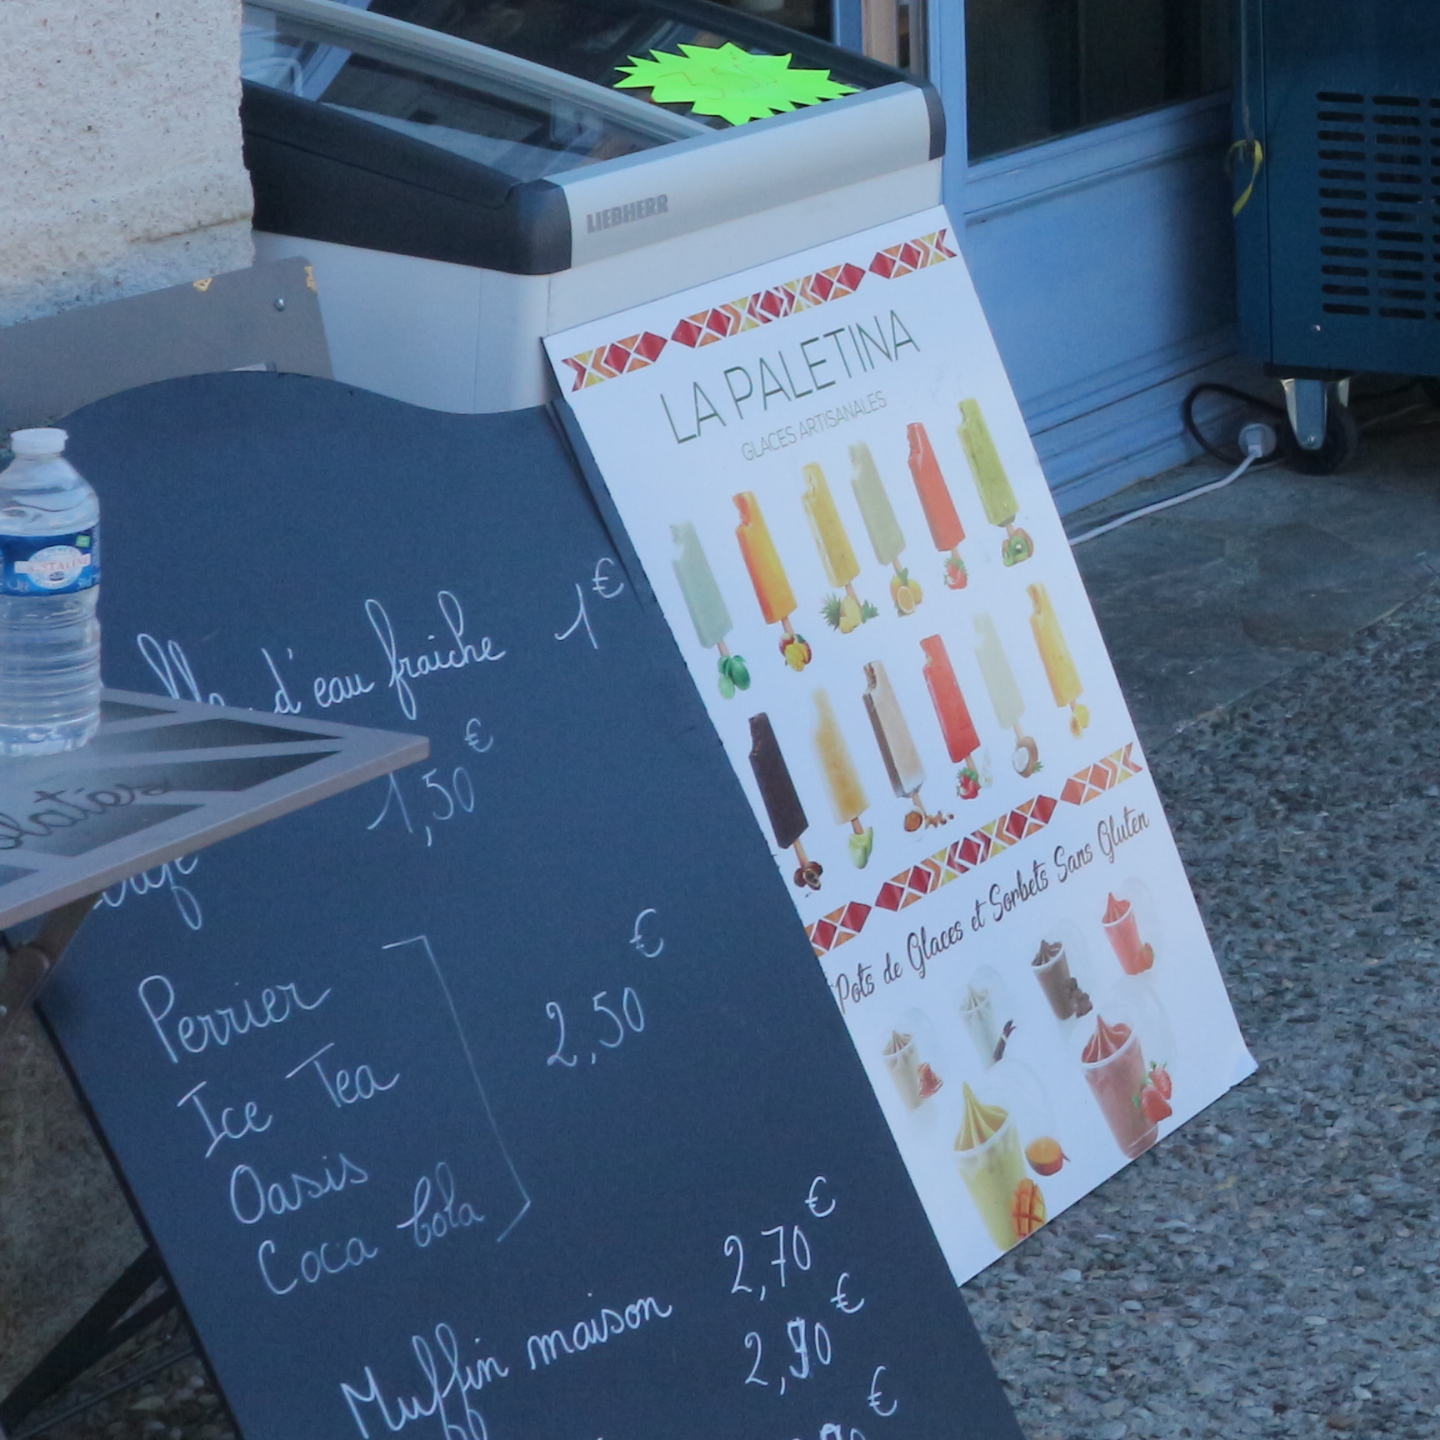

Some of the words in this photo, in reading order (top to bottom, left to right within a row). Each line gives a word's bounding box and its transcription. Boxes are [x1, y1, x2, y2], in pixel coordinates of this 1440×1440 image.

[586, 193, 669, 234] LIEBHERR
[660, 380, 727, 444] LA
[723, 309, 921, 420] PALETINA
[741, 425, 798, 462] GLACES
[800, 390, 888, 440] ARTISANALES
[832, 962, 875, 1014] Pots
[883, 952, 903, 986] de
[906, 920, 965, 980] Glaces
[971, 898, 987, 933] et
[988, 859, 1050, 923] Sorbets
[1053, 841, 1094, 884] Sans
[1096, 805, 1151, 864] Gluten
[138, 974, 332, 1064] Perrier
[176, 1080, 273, 1159] Ice
[285, 1041, 401, 1109] Tea
[230, 1152, 369, 1225] Oasis
[258, 1239, 379, 1296] Coca
[340, 1322, 509, 1440] Muffin
[527, 1290, 673, 1370] maison
